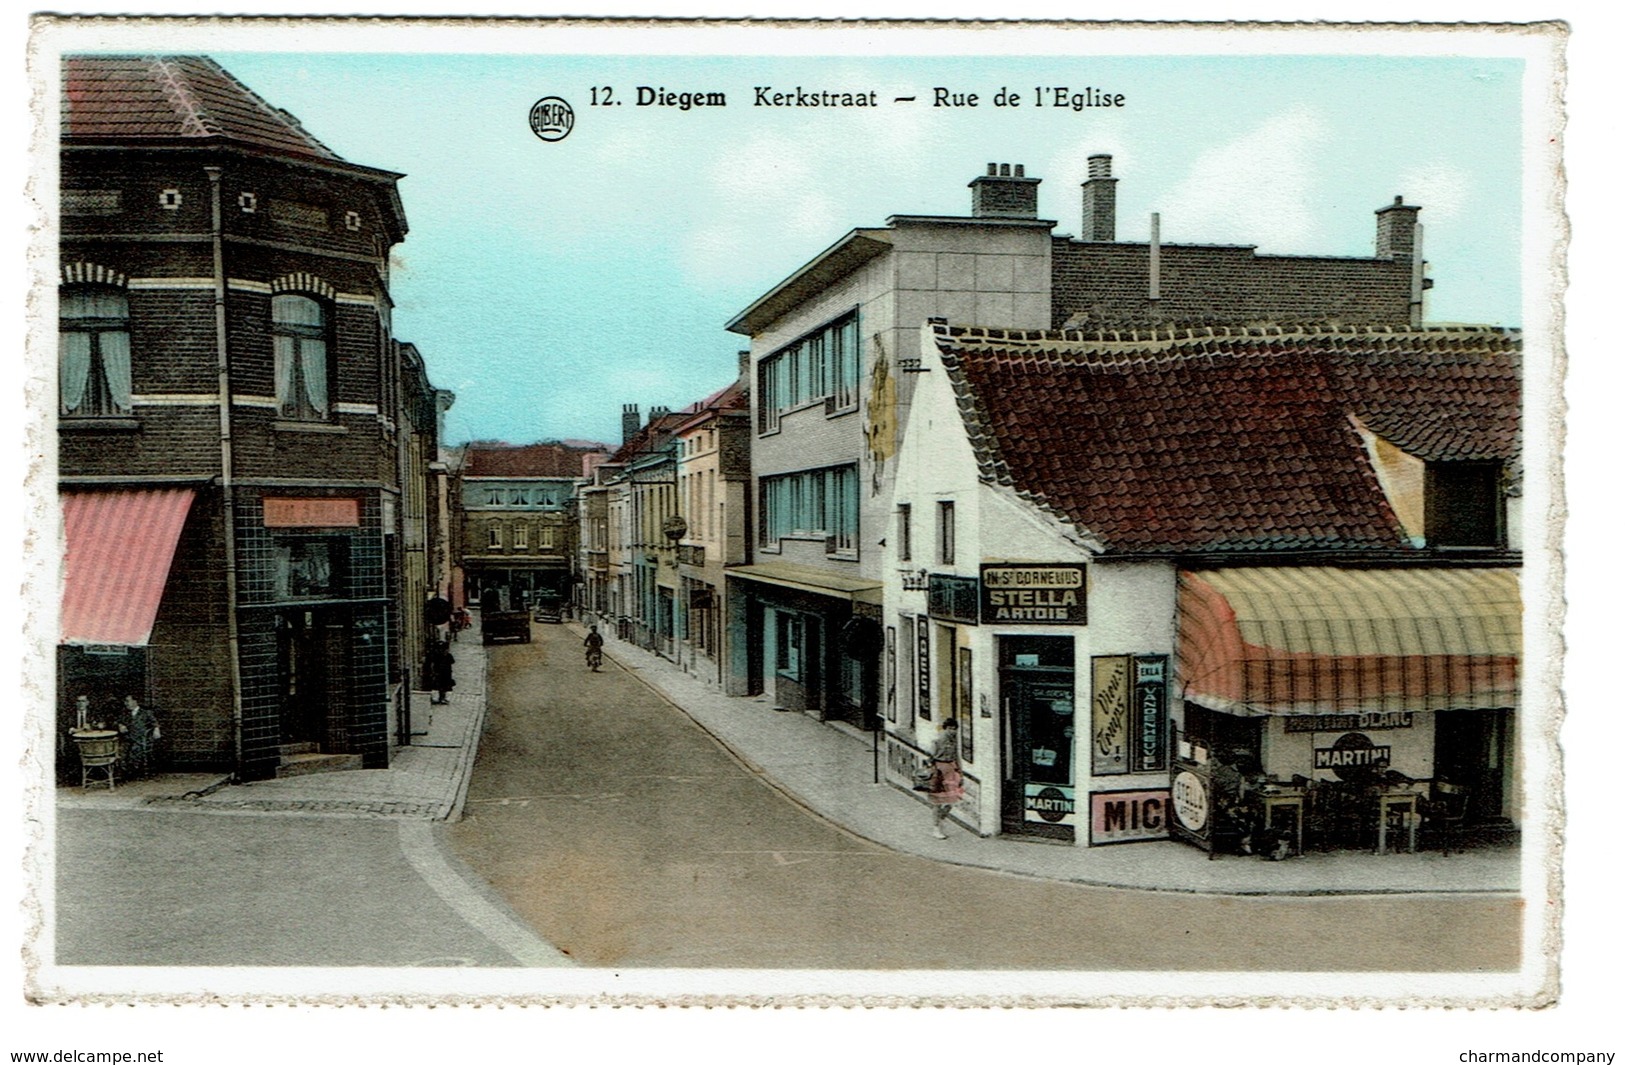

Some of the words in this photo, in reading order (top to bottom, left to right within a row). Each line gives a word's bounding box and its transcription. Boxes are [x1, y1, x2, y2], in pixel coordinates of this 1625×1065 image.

[1016, 571, 1079, 585] CORNELIUS
[990, 590, 1077, 606] STELLA
[996, 607, 1069, 620] ARTOIS
[1316, 748, 1389, 767] MARTINI
